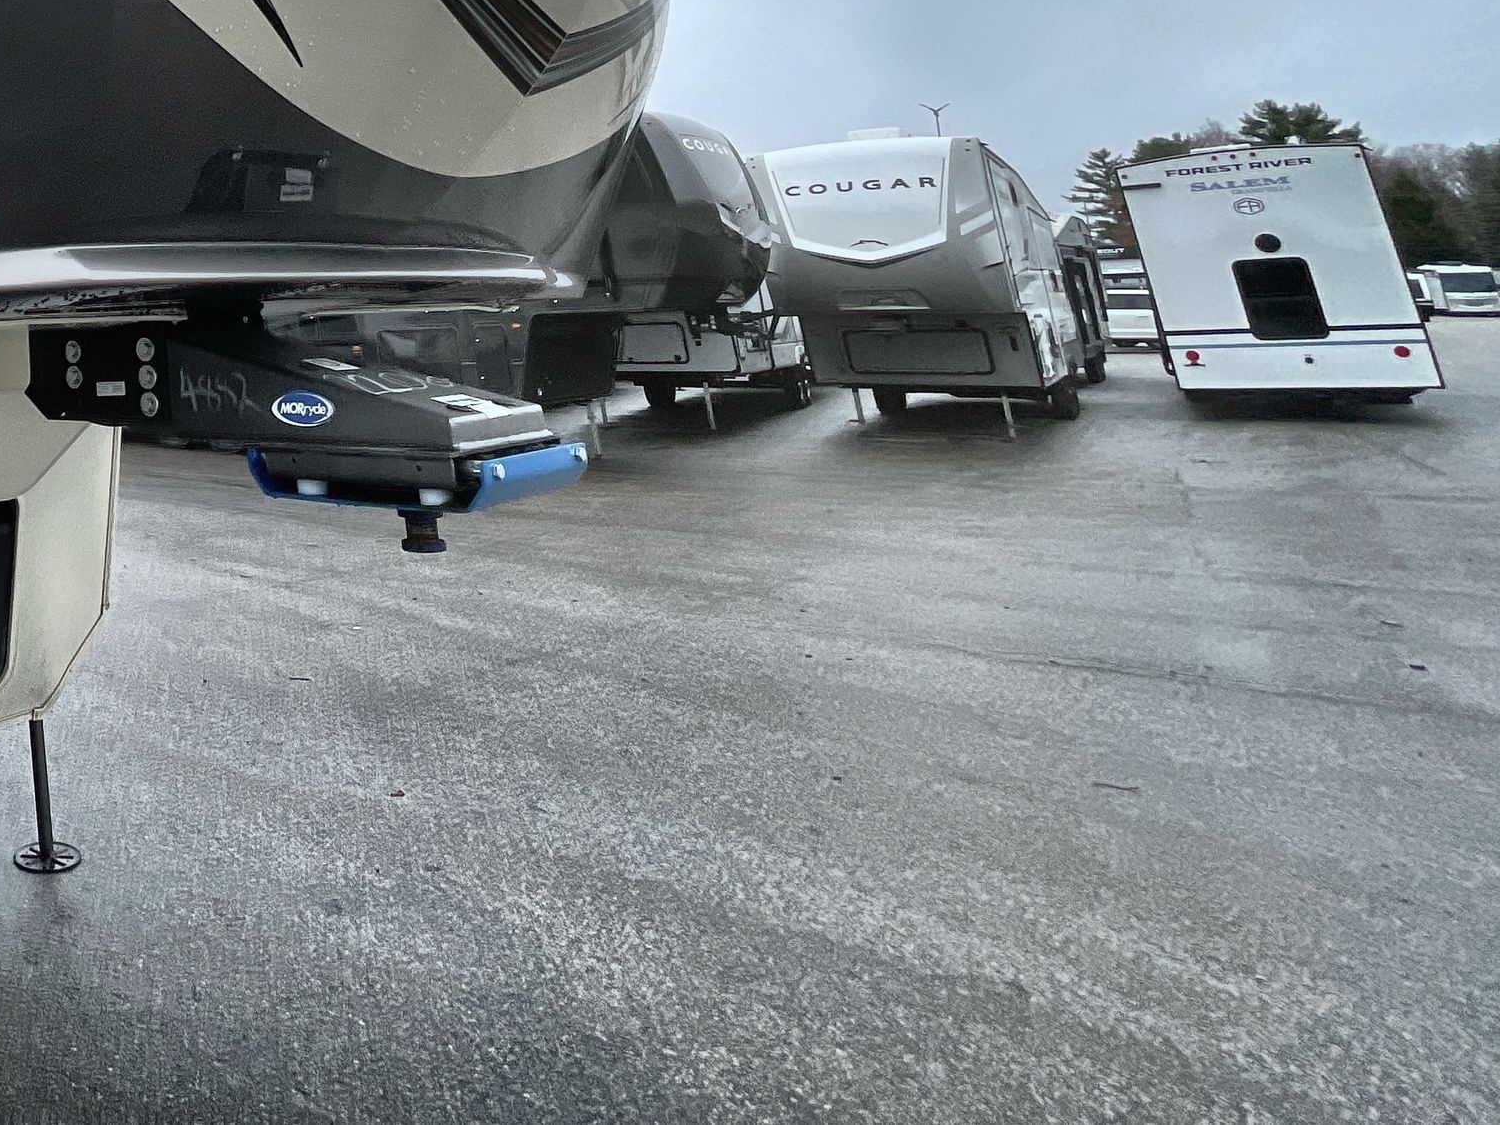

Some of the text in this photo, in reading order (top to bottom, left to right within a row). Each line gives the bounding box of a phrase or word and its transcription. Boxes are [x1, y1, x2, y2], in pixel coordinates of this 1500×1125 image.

[1165, 157, 1313, 177] FOREST RIVER
[785, 177, 937, 196] COUGAR
[1190, 176, 1291, 192] SALEM
[279, 401, 327, 417] MORryde
